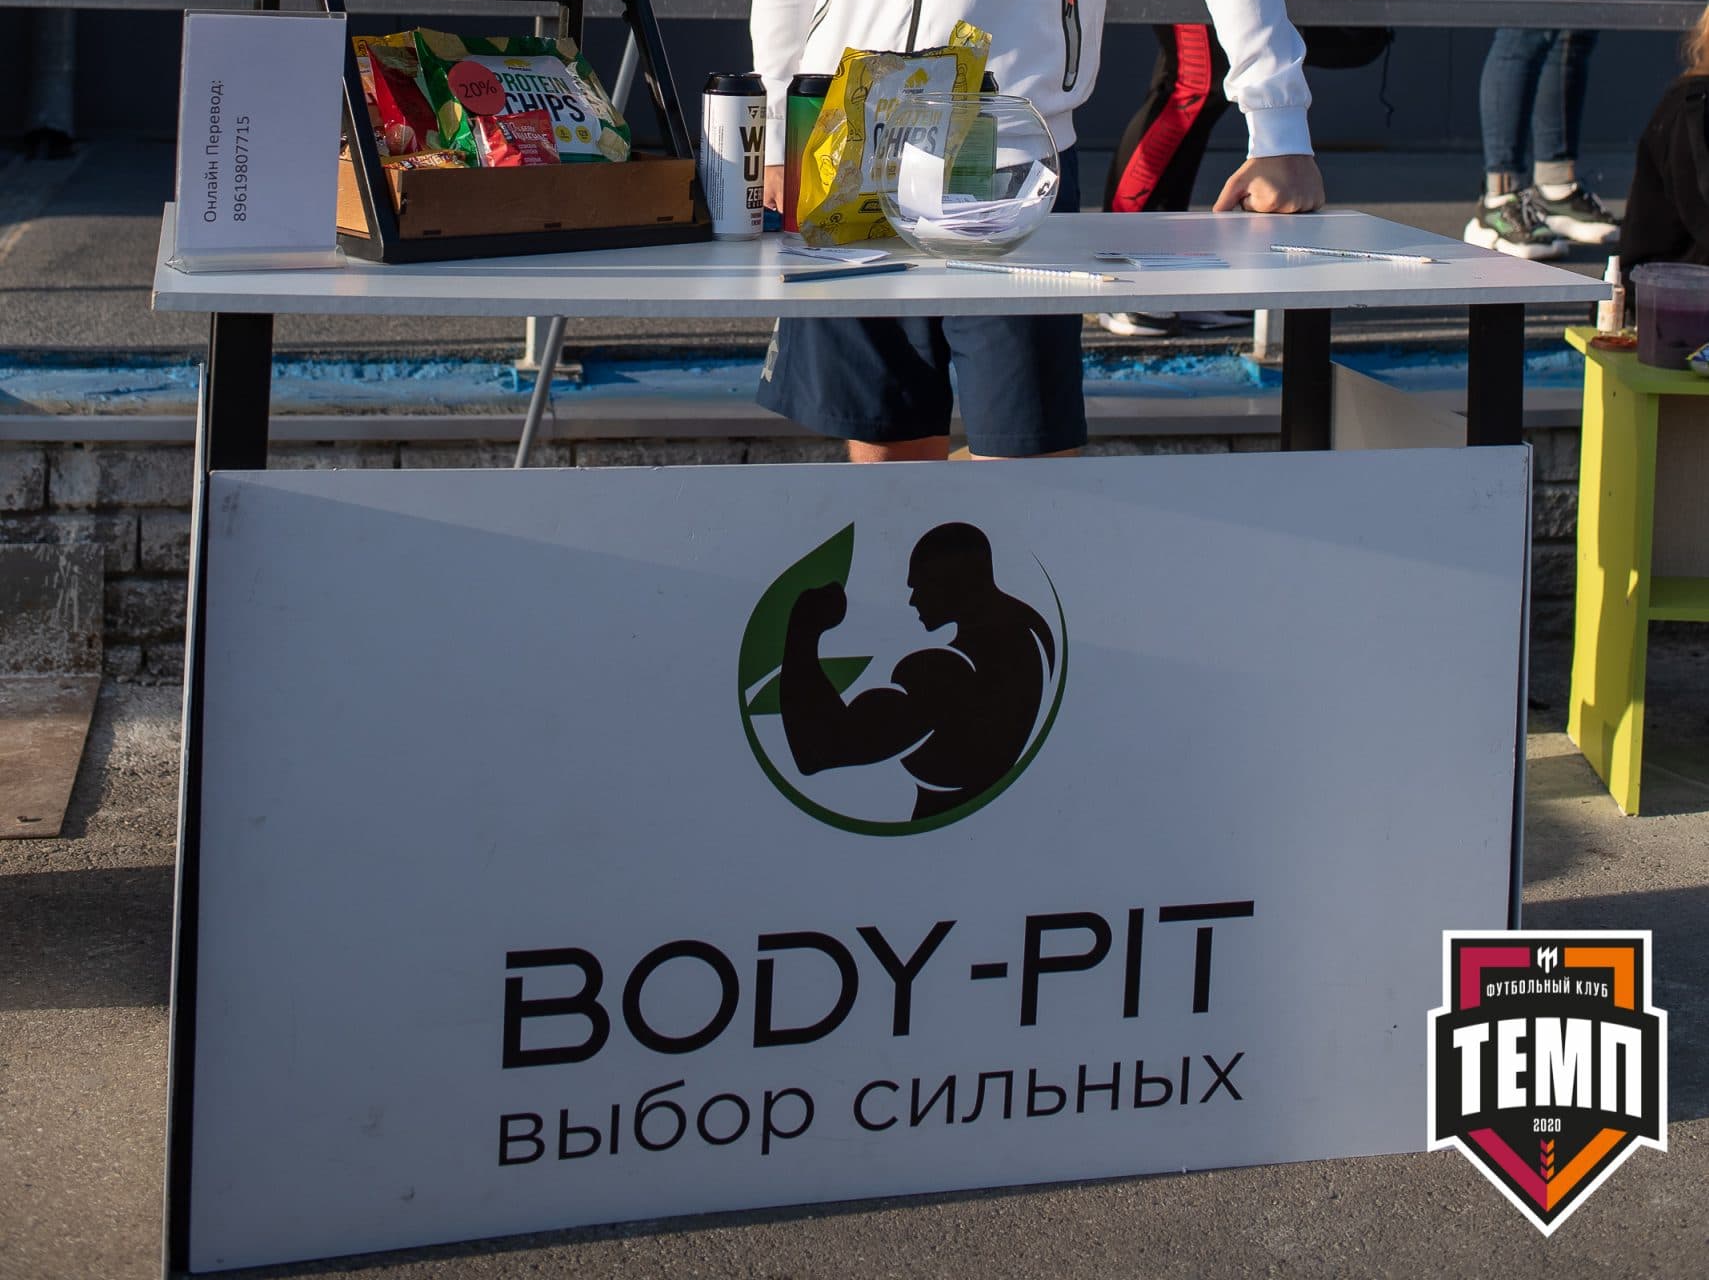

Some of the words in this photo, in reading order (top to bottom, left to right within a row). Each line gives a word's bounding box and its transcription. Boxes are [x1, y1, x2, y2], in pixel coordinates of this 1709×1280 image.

[205, 79, 224, 156] Перевод:
[458, 79, 498, 99] 20%
[505, 92, 585, 122] CHIPS
[203, 161, 219, 223] Онлайн
[233, 115, 250, 223] 89619807715
[501, 900, 1255, 1069] BODY-PIT
[498, 1080, 815, 1167] выбор
[853, 1052, 1245, 1132] сильных
